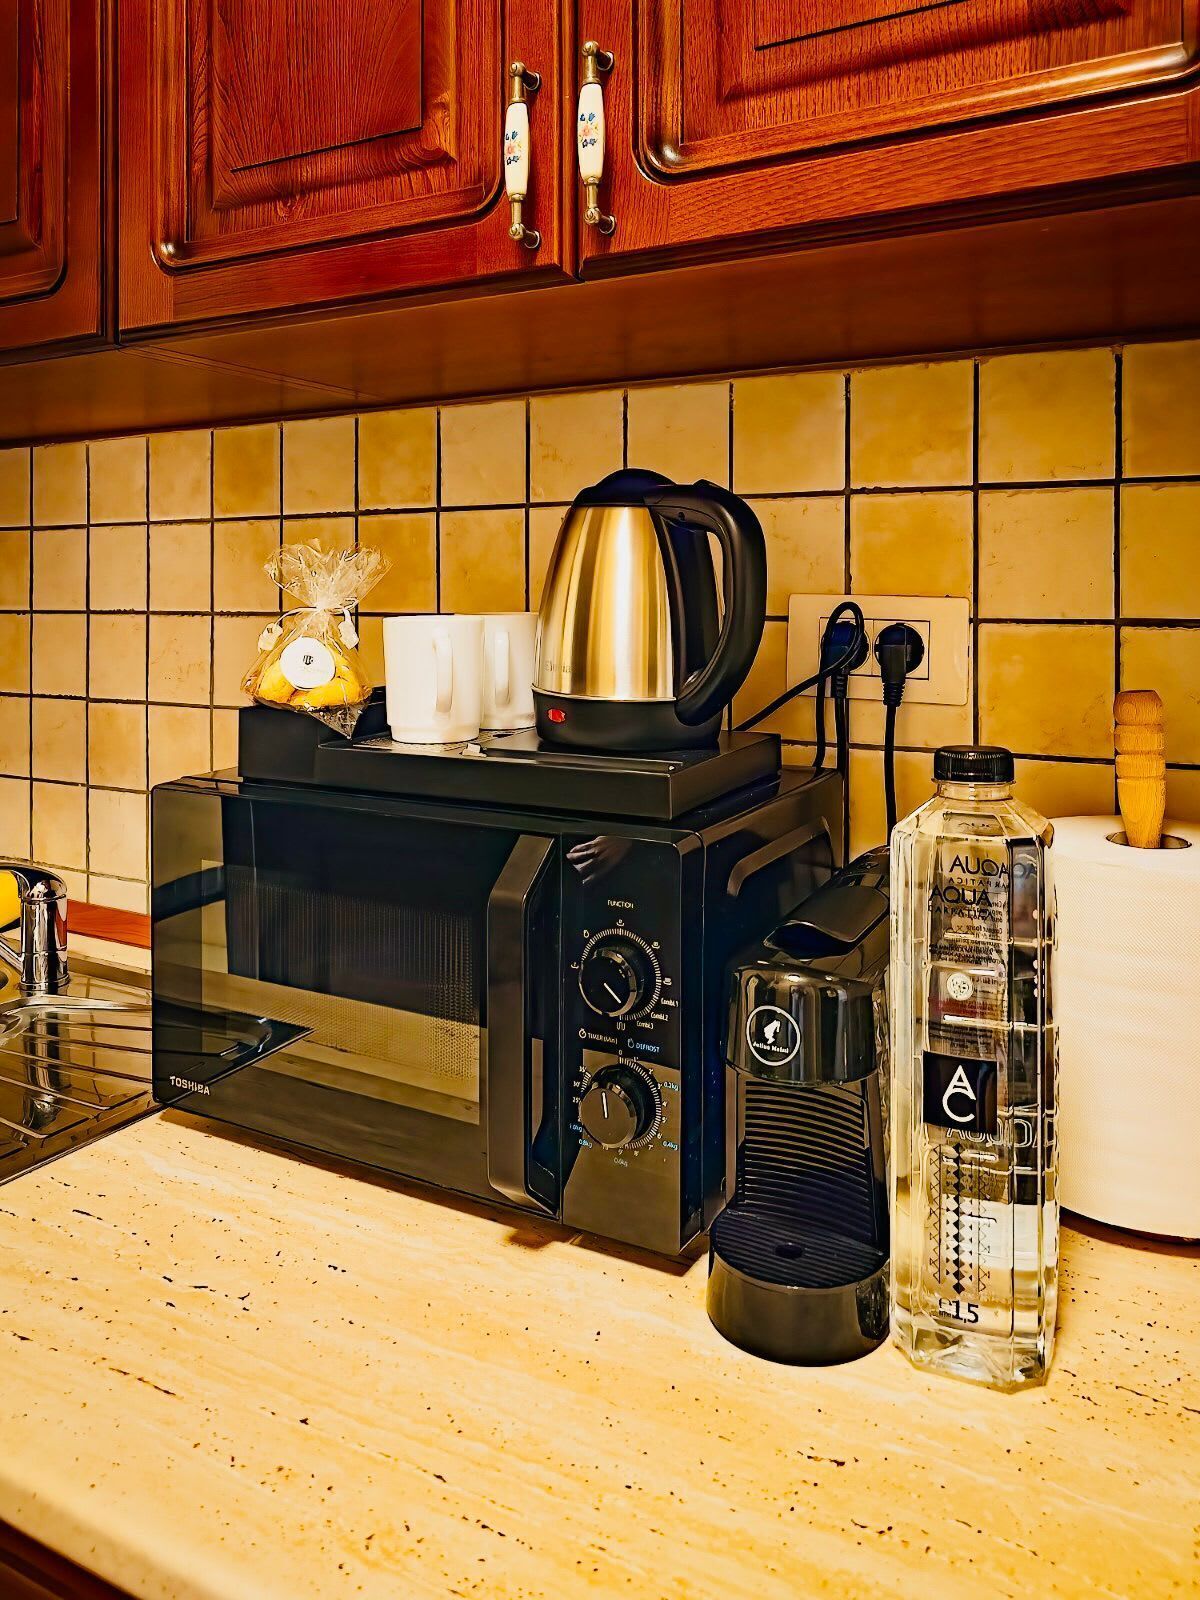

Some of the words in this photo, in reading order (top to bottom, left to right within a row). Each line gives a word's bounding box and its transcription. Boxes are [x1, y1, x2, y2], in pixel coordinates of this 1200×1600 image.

[928, 883, 993, 907] AQUA
[607, 899, 634, 909] FUNCTION
[587, 1032, 603, 1041] TIMER
[635, 1042, 660, 1053] DEFROST
[169, 1075, 210, 1096] TOSHIBA
